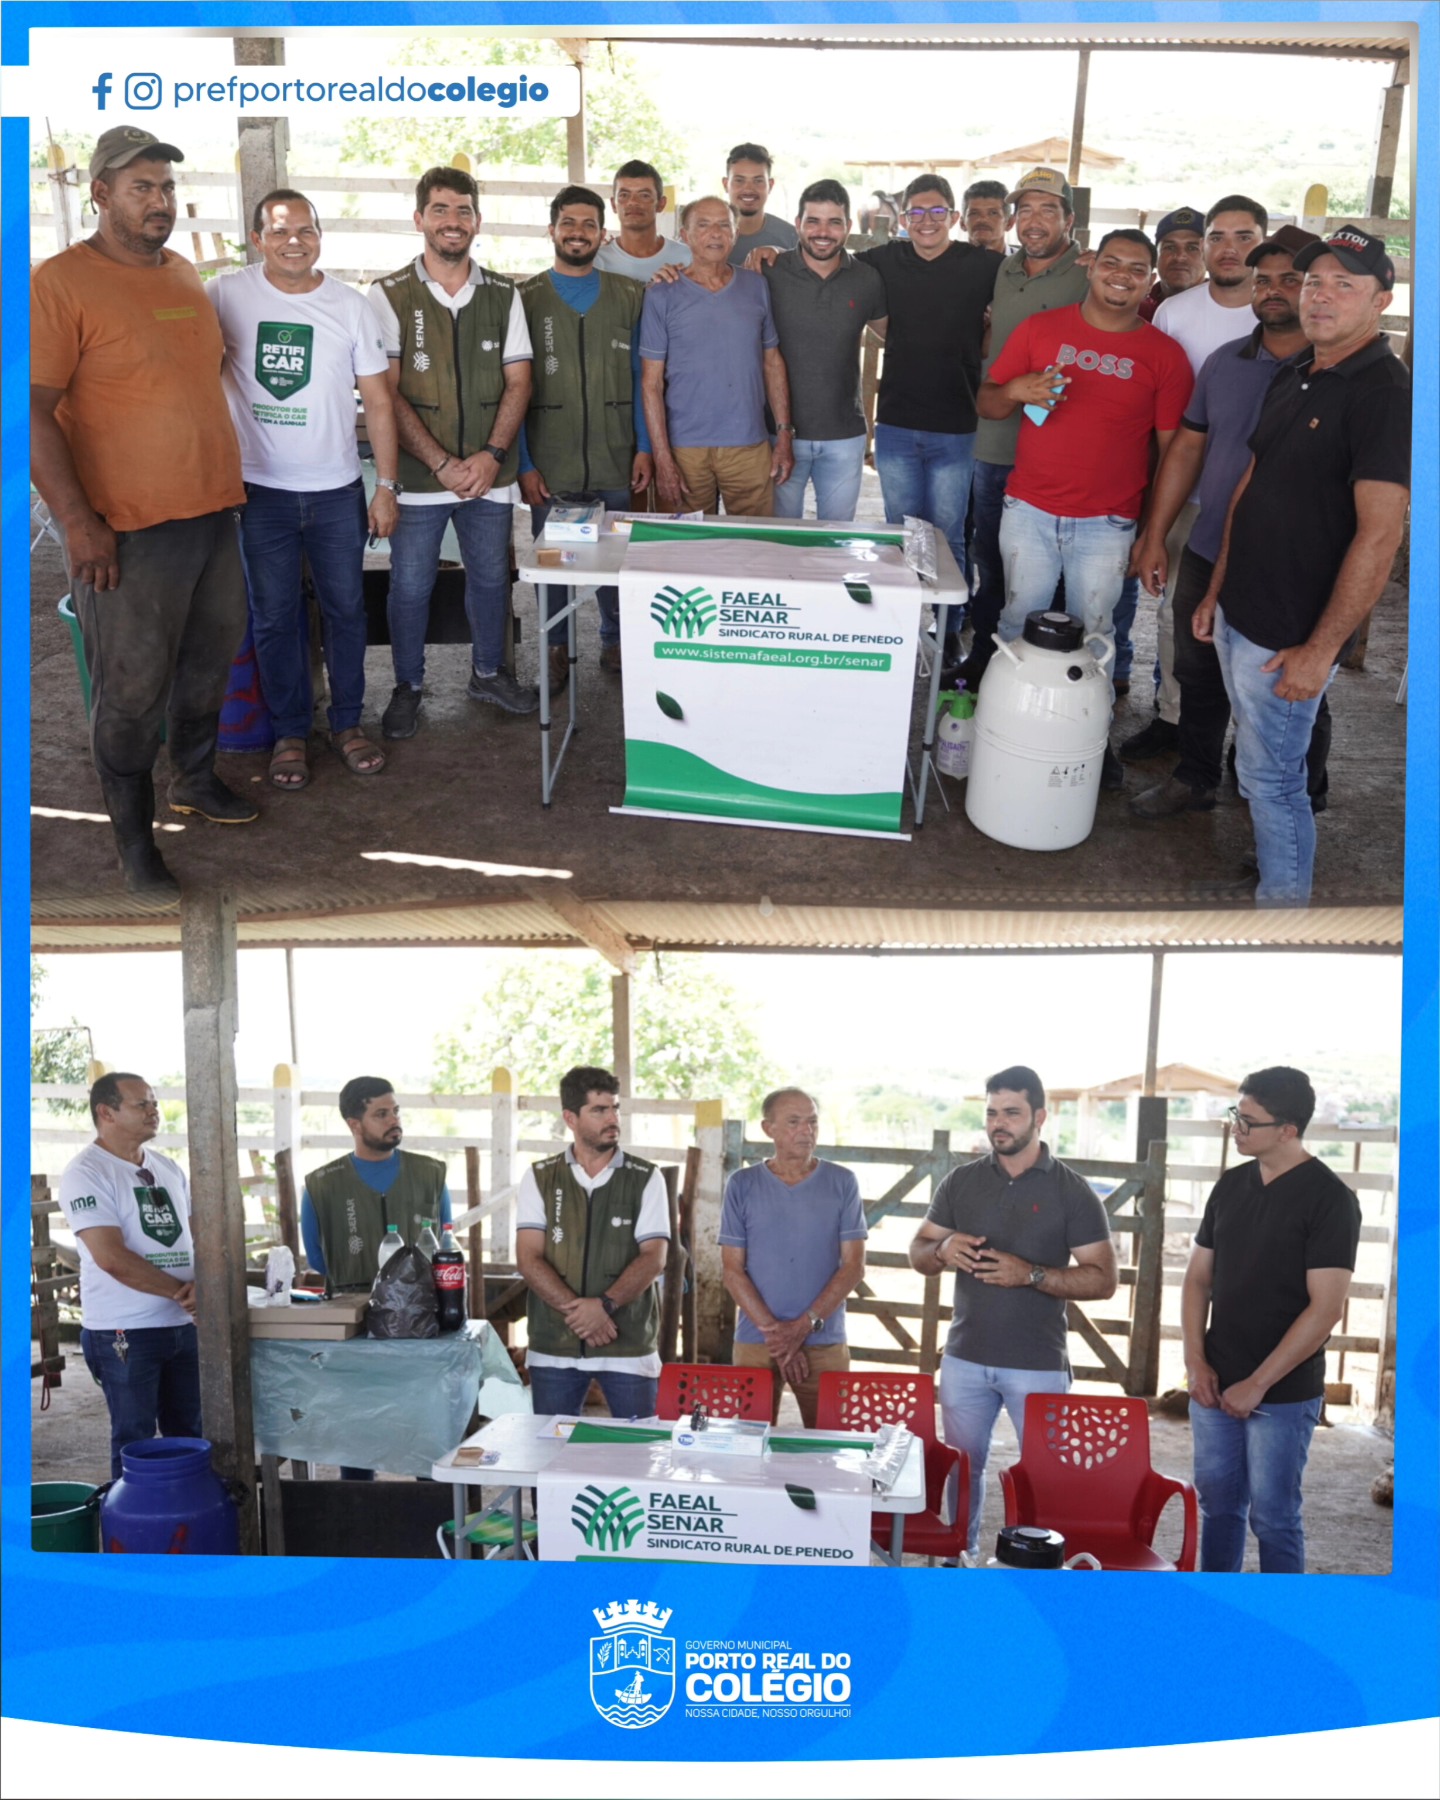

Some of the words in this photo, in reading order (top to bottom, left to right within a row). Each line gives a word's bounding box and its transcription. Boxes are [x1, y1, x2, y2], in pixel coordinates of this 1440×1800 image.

[414, 309, 425, 348] SENAR
[544, 316, 554, 353] SENAR
[262, 343, 305, 357] RETIFI
[262, 354, 304, 372] CAR
[1055, 343, 1135, 380] BOSS
[252, 403, 291, 413] PRODUTOR
[721, 591, 787, 607] FAEAL
[719, 608, 788, 625] SENAR
[718, 628, 786, 640] SINDICATO
[788, 631, 830, 642] RURAL
[832, 633, 849, 643] DE
[851, 634, 904, 645] PENEDO
[661, 646, 885, 668] www.sistemafaeal.org.br/senar
[70, 1195, 97, 1212] IMA
[144, 1212, 174, 1224] CAR
[346, 1198, 357, 1233] SENAR
[649, 1492, 722, 1512] FAEAL
[646, 1514, 724, 1534] SENAR
[647, 1538, 721, 1551] SINDICATO
[724, 1542, 771, 1555] RURAL
[773, 1545, 793, 1556] DE
[795, 1546, 854, 1560] PENEDO
